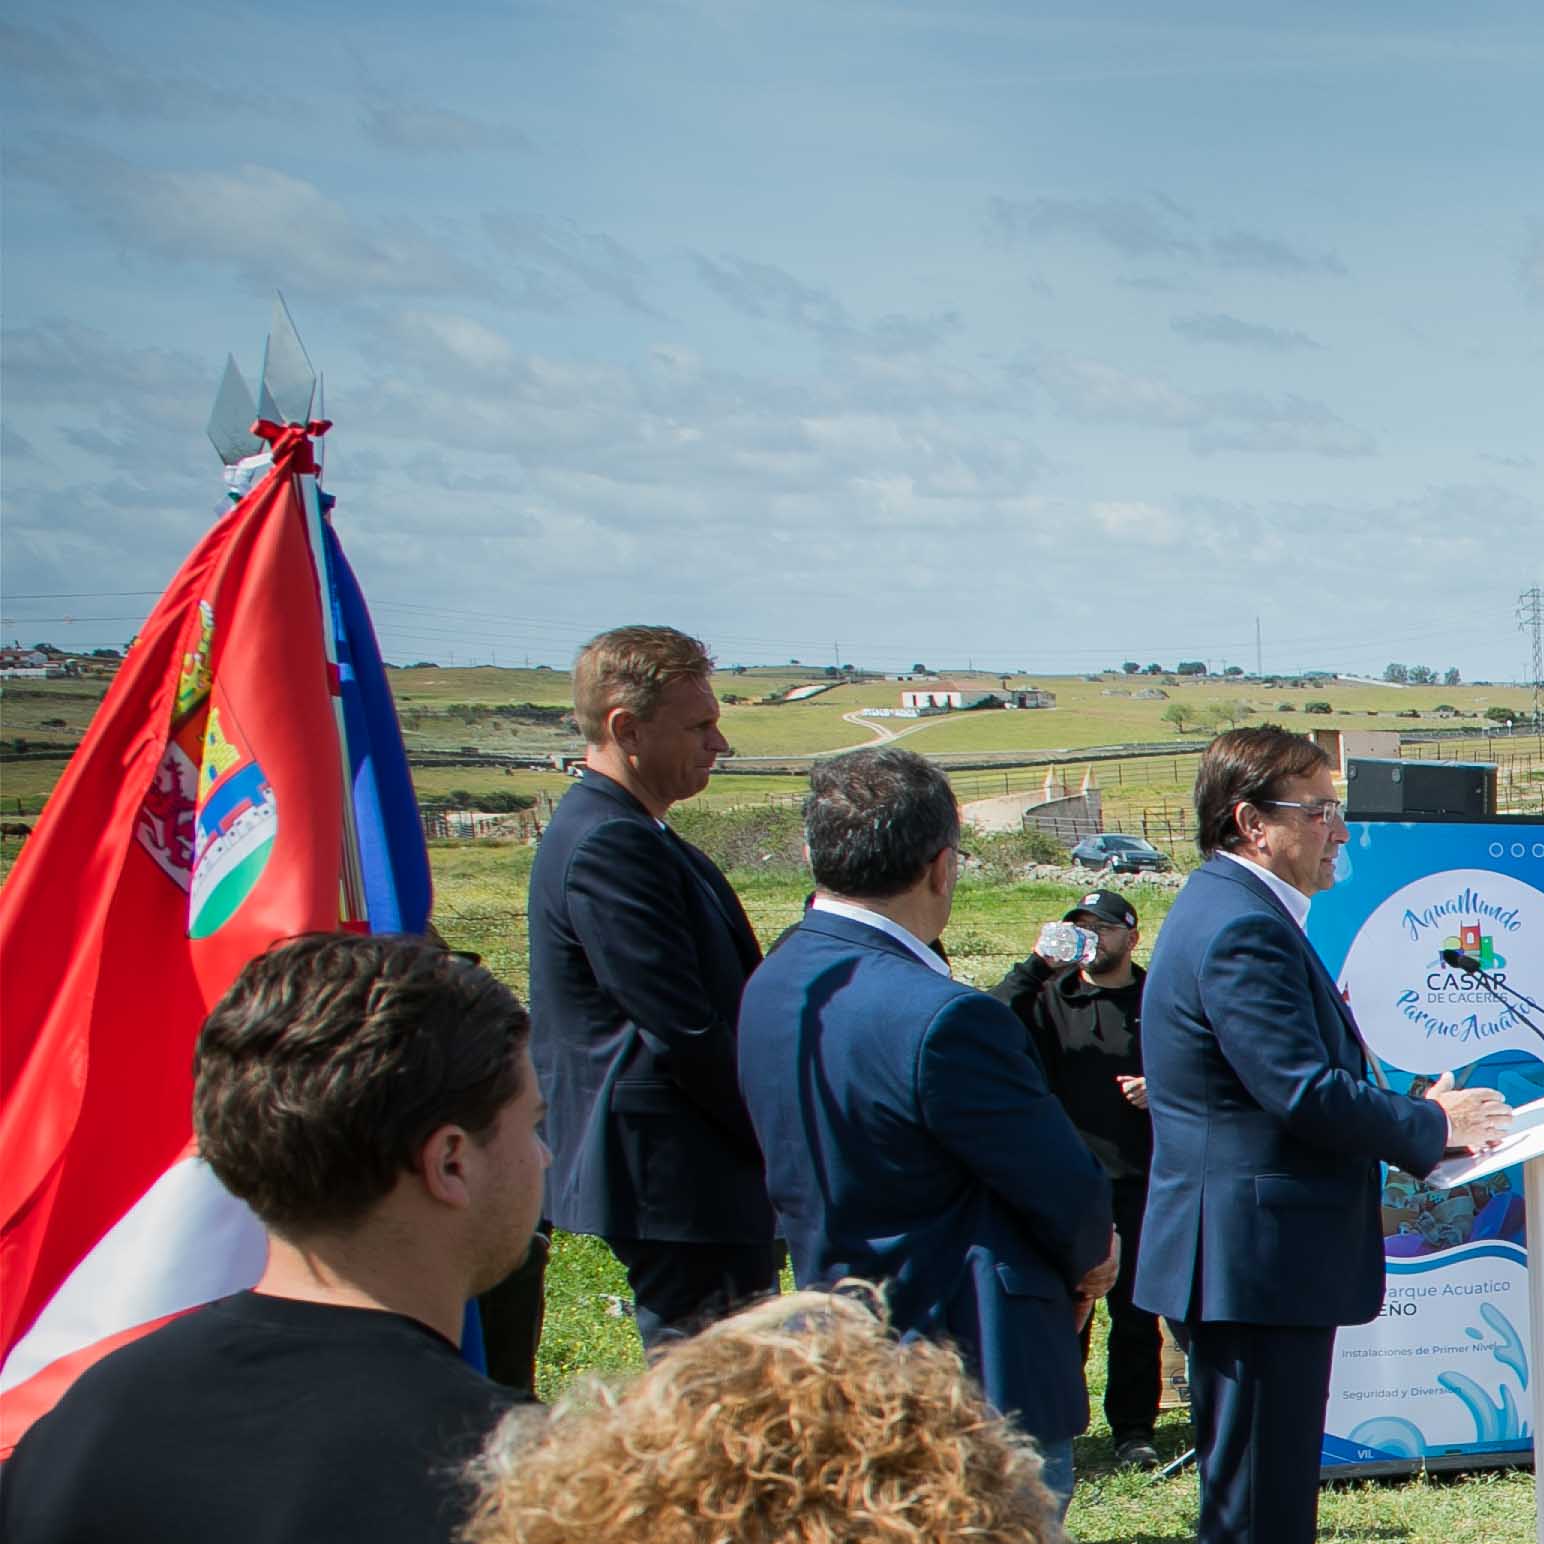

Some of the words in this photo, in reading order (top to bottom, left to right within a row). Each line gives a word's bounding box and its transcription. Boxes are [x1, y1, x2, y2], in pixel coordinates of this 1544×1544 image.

[1427, 973, 1507, 991] CASAR
[1427, 993, 1445, 1003] DE
[1396, 990, 1459, 1039] Parque
[1386, 1285, 1437, 1300] arque
[1415, 1346, 1430, 1356] de
[1432, 1345, 1469, 1355] Primer
[1472, 1342, 1497, 1352] Nivel
[1343, 1389, 1399, 1401] Seguridad
[1401, 1390, 1409, 1400] y
